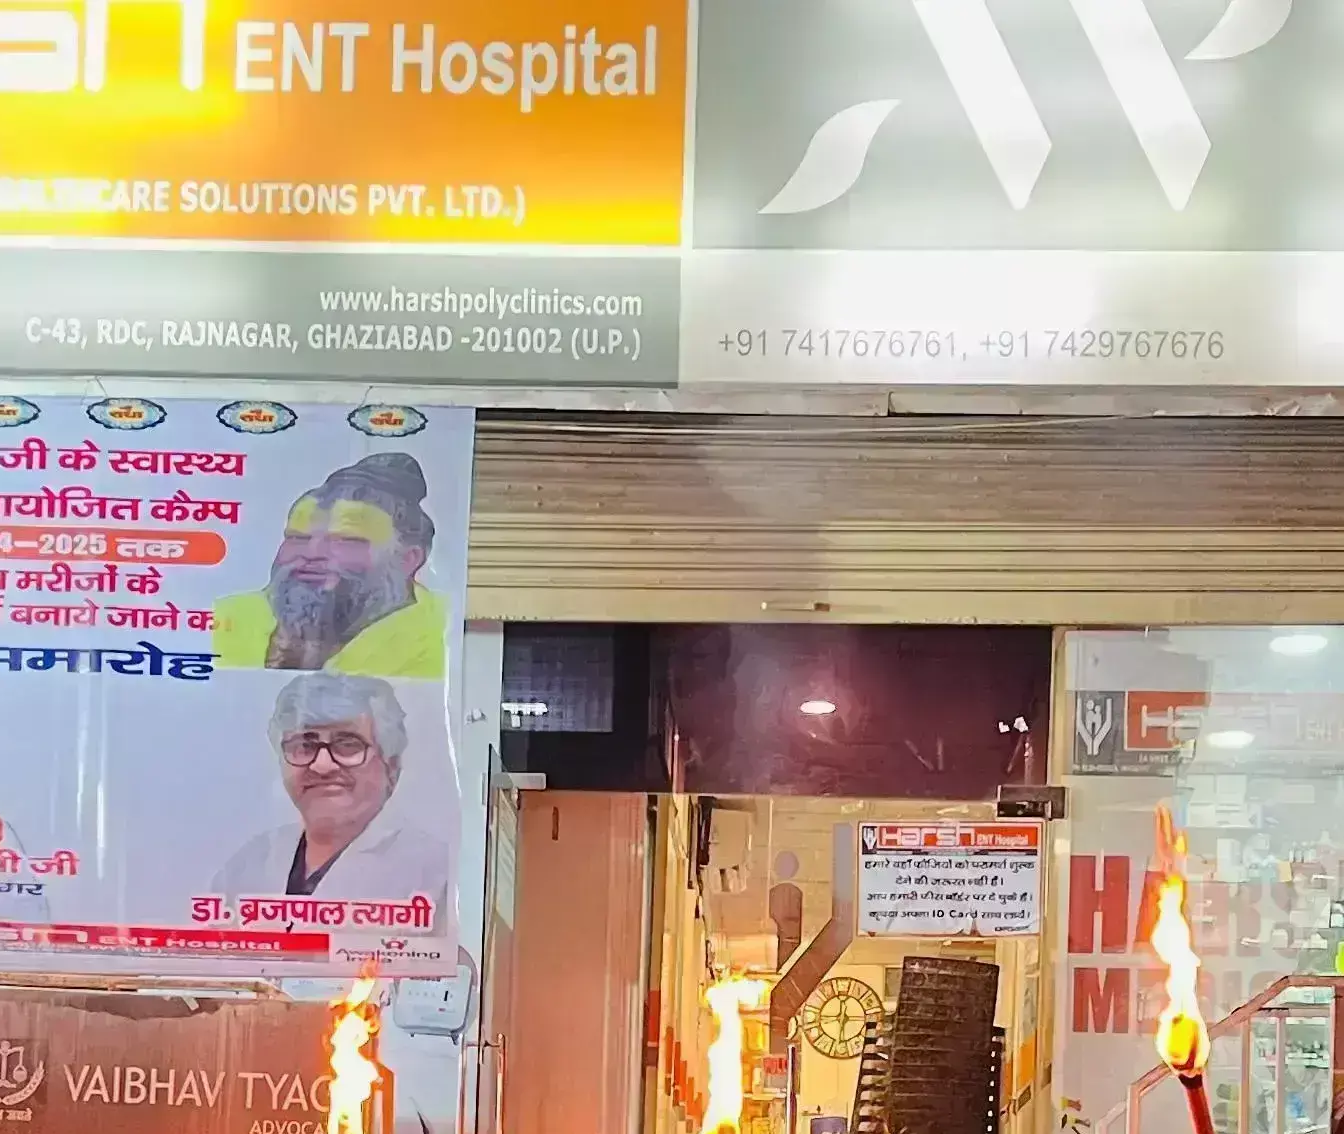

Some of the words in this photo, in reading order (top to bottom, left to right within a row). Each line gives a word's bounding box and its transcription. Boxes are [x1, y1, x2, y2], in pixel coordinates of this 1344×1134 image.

[235, 22, 369, 92] ENT
[391, 25, 657, 114] Hospital
[179, 181, 357, 217] SOLUTIONS
[367, 186, 436, 218] PVT.
[444, 186, 526, 226] LTD.)
[319, 286, 643, 319] www.harshpolyclinics.com
[25, 317, 88, 350] C-43,
[96, 319, 153, 353] RDC,
[162, 321, 300, 355] RAJNAGAR,
[307, 325, 452, 353] GHAZIABAD
[460, 328, 563, 356] -201002
[570, 328, 642, 360] (U.P.)
[718, 329, 768, 358] +91
[782, 329, 968, 362] 7417676761,
[979, 330, 1031, 359] +91
[1044, 330, 1225, 360] 7429767676
[58, 440, 101, 472] के
[109, 450, 247, 477] स्वास्थ्य
[150, 488, 241, 524] कैम्प
[116, 537, 189, 559] तक
[16, 562, 118, 594] मरीजों
[125, 565, 164, 596] के
[10, 598, 98, 628] बनाये
[107, 600, 180, 632] जाने
[29, 849, 80, 876] जी
[191, 896, 231, 924] डा.
[240, 897, 345, 929] ब्रजपाल
[352, 894, 433, 927] त्यागी
[932, 910, 945, 919] ID
[949, 909, 979, 920] Card
[166, 937, 282, 951] Hospital
[64, 1063, 225, 1108] VAIBHAV
[238, 1071, 333, 1113] TYAG
